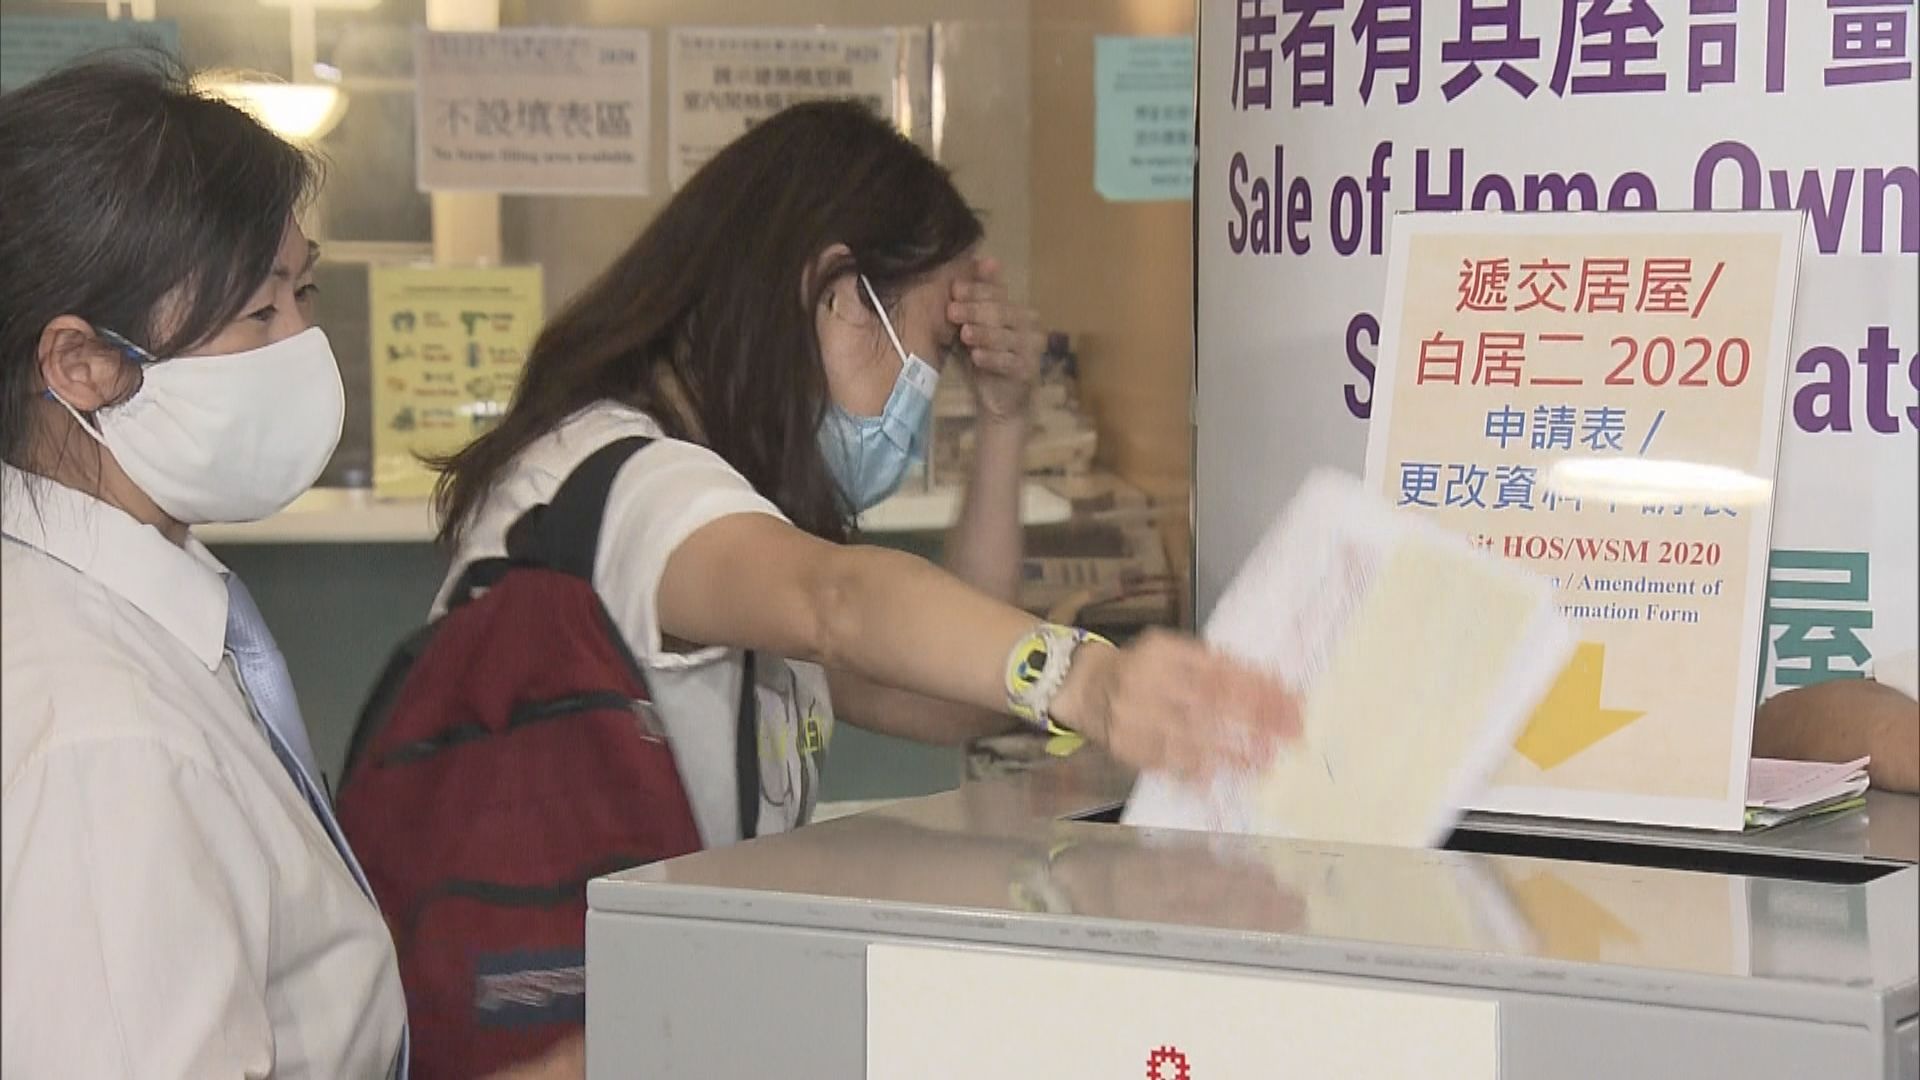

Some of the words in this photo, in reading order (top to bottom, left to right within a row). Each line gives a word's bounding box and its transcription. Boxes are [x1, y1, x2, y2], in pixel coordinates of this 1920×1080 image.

[1228, 144, 1312, 256] Sale
[1330, 140, 1393, 257] of
[1416, 330, 1584, 388] 白居二
[1604, 336, 1751, 388] 2020
[1485, 404, 1627, 451] 申請表
[1503, 536, 1649, 564] HOS/WSM
[1658, 541, 1721, 565] 2020
[1577, 574, 1695, 594] Amendment
[1702, 579, 1723, 596] of
[1557, 602, 1640, 620] rmation
[1646, 604, 1700, 623] Form
